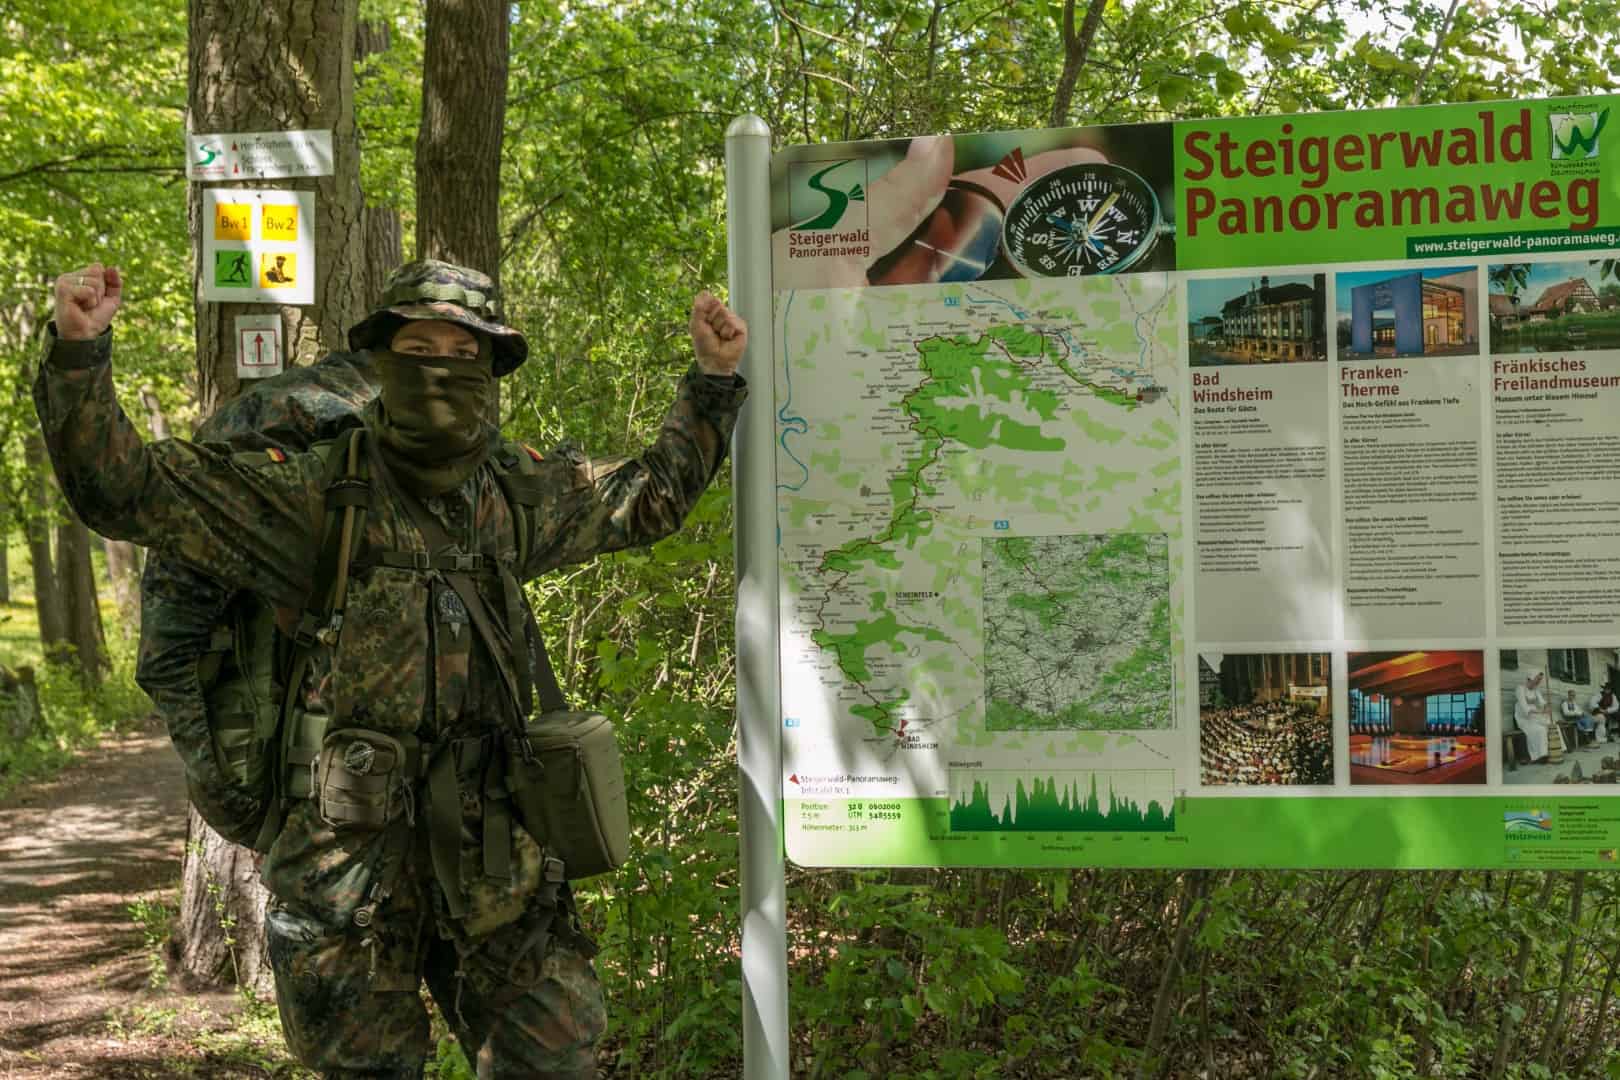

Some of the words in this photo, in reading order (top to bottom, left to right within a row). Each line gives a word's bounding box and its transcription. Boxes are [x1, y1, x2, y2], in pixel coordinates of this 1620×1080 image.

[1184, 109, 1532, 188] Steigerwald
[1186, 177, 1600, 236] Panoramaweg
[789, 229, 869, 247] Steigerwald
[1414, 233, 1620, 252] www.steigerwald-panoramaweg.
[789, 246, 870, 258] Panoramaweg
[1341, 366, 1408, 380] Franken-
[1494, 358, 1586, 374] Fränkisches
[1193, 372, 1219, 386] Bad
[1494, 376, 1620, 391] Freilandmuseum
[1193, 387, 1273, 402] Windsheim
[1341, 383, 1400, 397] Therme
